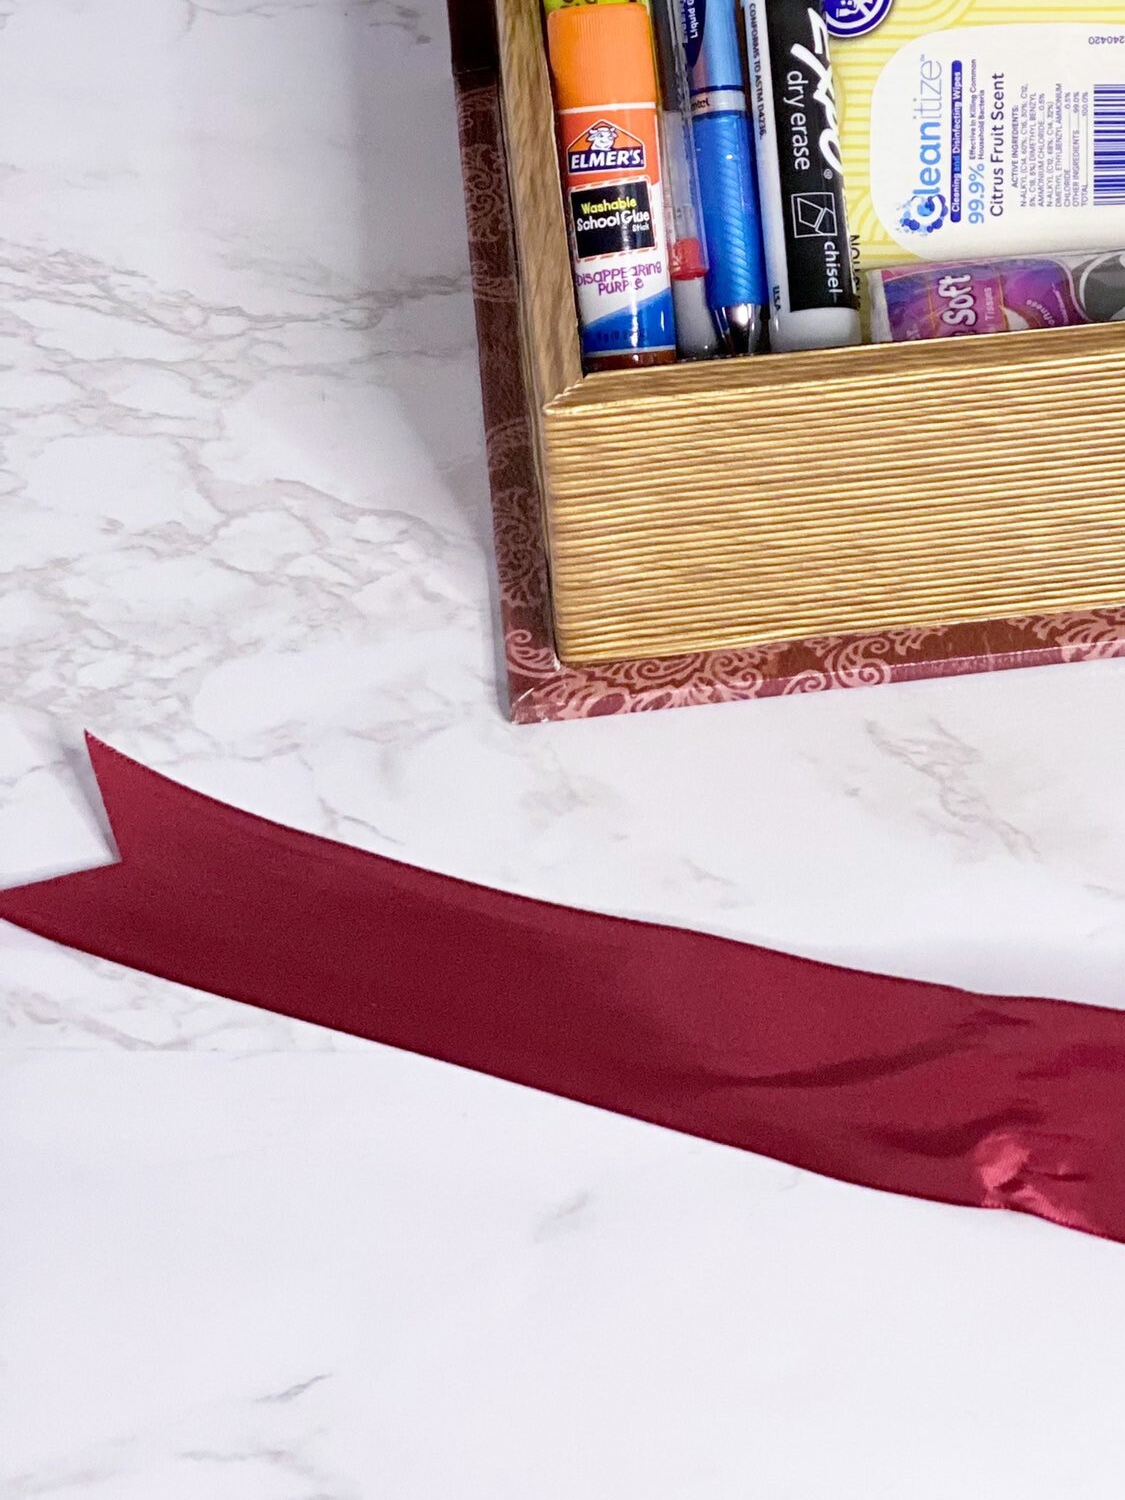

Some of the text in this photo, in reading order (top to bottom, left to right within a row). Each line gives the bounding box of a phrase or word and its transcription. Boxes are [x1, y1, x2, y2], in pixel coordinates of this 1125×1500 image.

[688, 7, 698, 38] Liquid
[747, 3, 761, 58] CONFORMS
[1088, 35, 1124, 44] 240420
[753, 60, 761, 72] TO
[969, 58, 977, 92] Common
[753, 74, 764, 102] ASTM
[780, 69, 812, 171] dry erase
[969, 94, 978, 117] Killing
[906, 59, 946, 222] Cleanitize
[977, 89, 985, 159] Household Bacteria
[951, 71, 962, 212] Cleaning and Disinfecting Wipes
[968, 127, 976, 159] Effective
[989, 72, 1004, 216] Citrus Fruit Scent
[570, 148, 641, 169] ELMER'S
[1010, 159, 1018, 187] ACTIVE
[967, 163, 985, 223] 99.9%
[1037, 160, 1045, 206] AMMONIUM
[576, 207, 649, 231] School Glue
[580, 196, 636, 213] Washable
[631, 222, 649, 232] Stick
[822, 240, 844, 294] chisel
[937, 274, 977, 326] Soft
